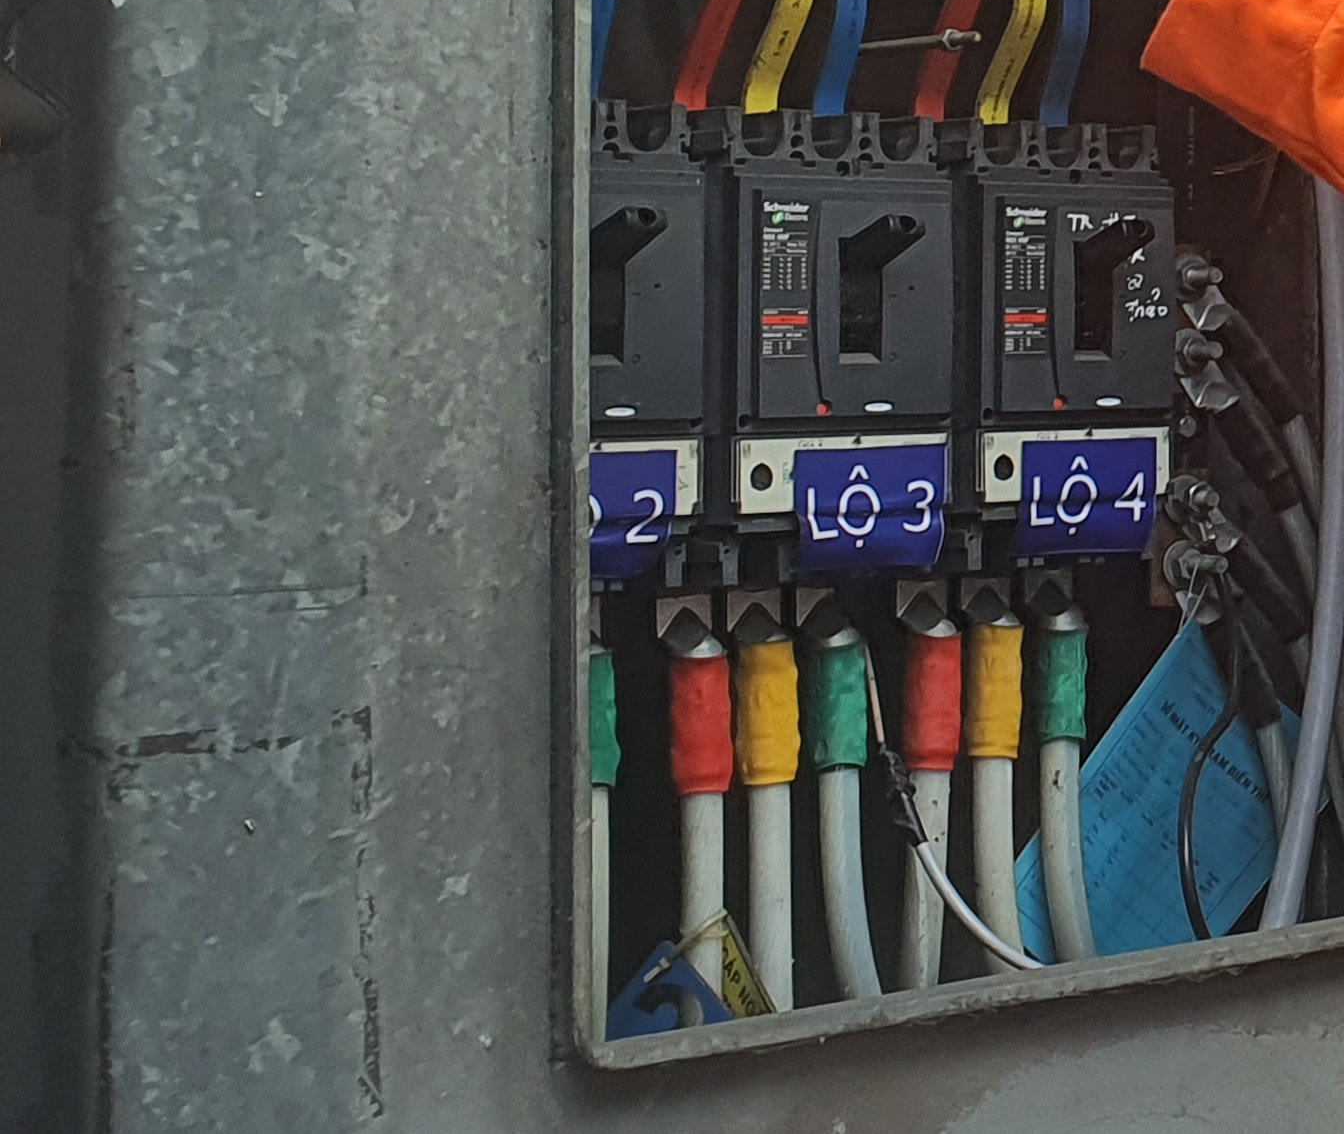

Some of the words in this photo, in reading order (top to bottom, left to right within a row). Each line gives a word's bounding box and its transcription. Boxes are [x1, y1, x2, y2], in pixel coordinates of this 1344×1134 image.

[626, 488, 664, 544] 2
[806, 464, 882, 548] LỘ
[902, 479, 937, 533] 3
[1028, 455, 1099, 535] LỘ
[1113, 471, 1147, 522] 4
